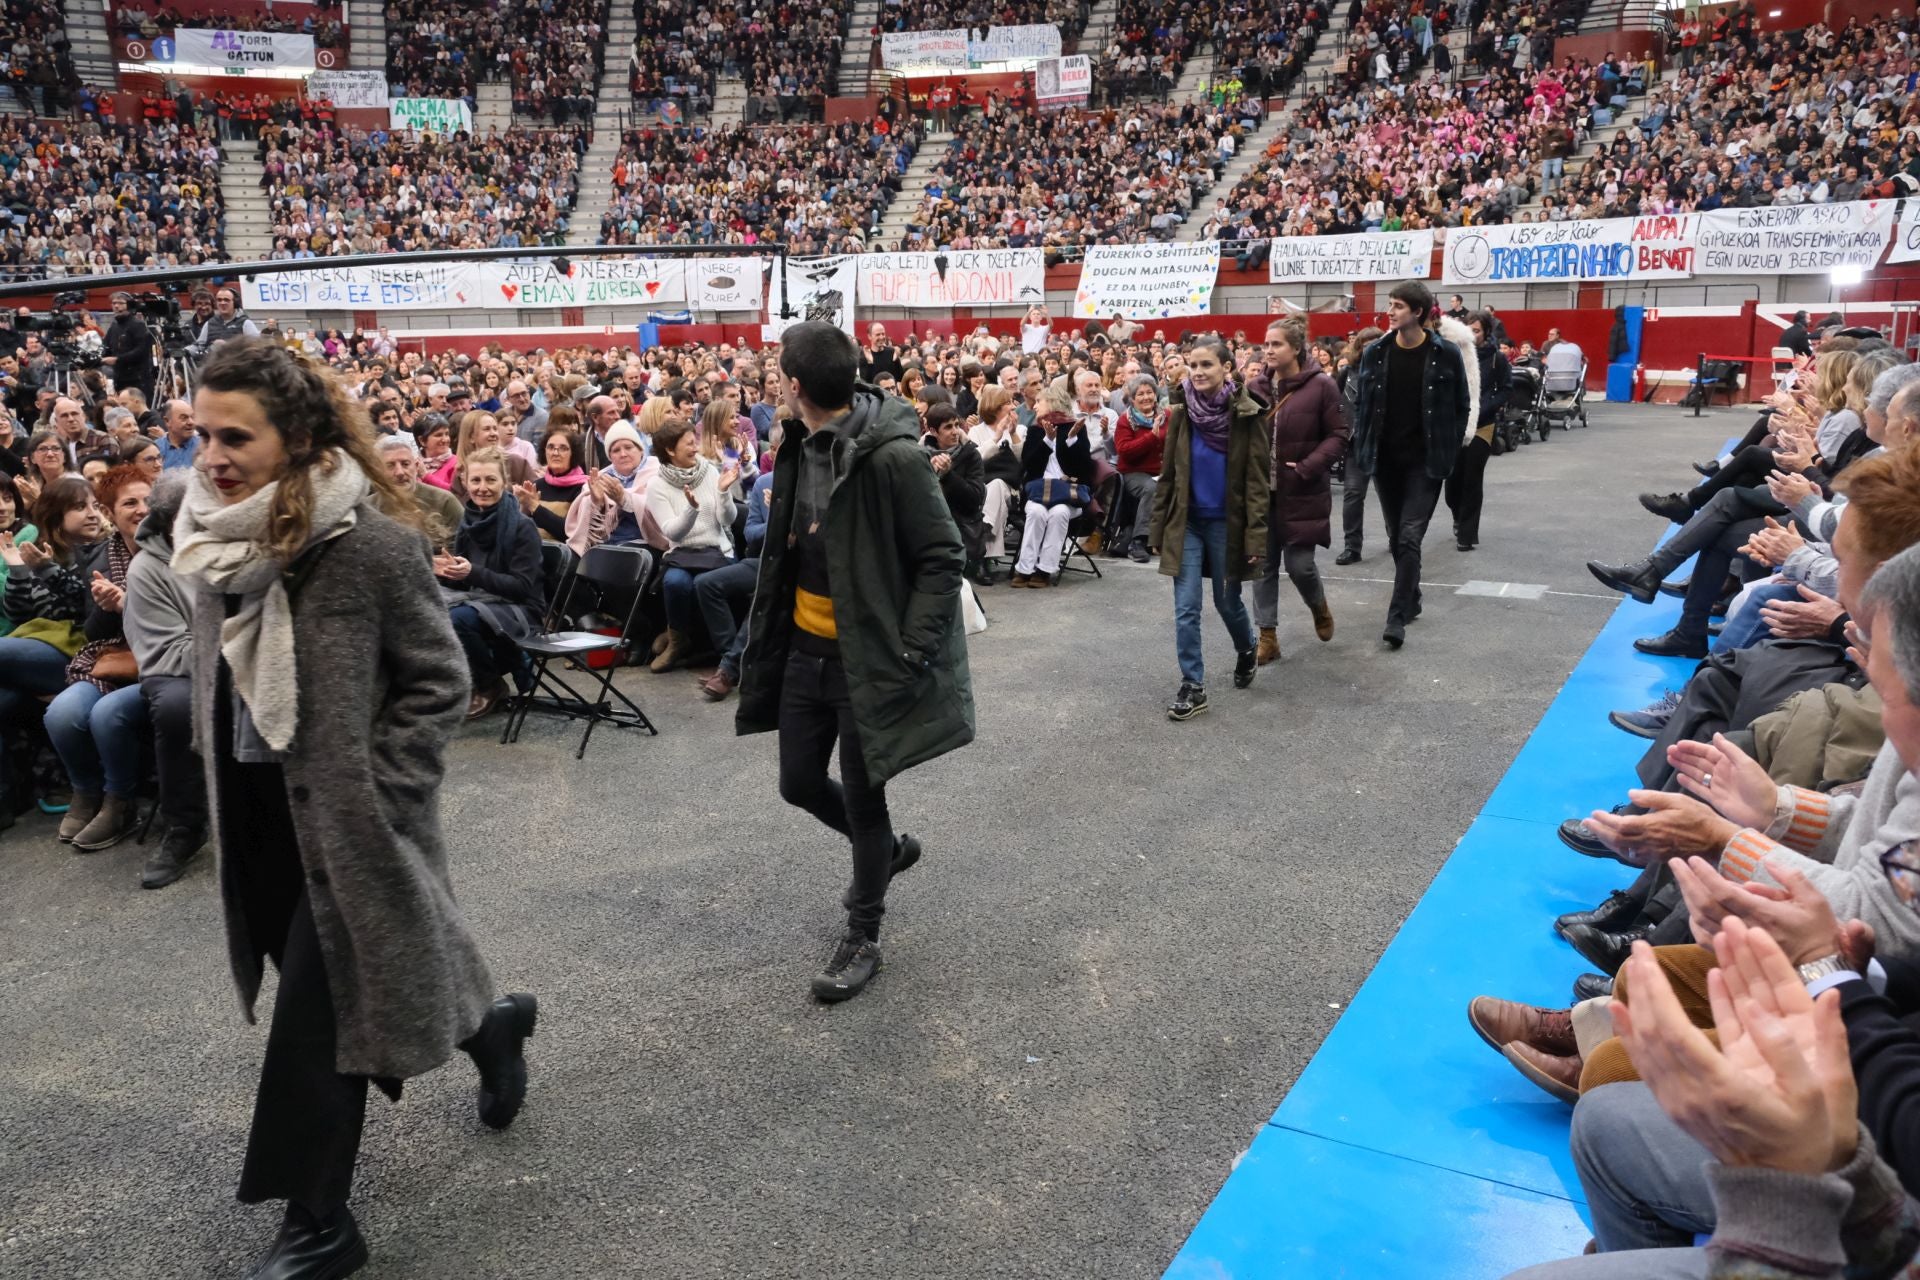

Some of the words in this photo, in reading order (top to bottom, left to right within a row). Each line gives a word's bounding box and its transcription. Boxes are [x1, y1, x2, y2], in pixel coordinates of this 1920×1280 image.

[227, 51, 274, 62] GATTUN
[1064, 56, 1085, 69] AUPA
[1061, 70, 1088, 82] NEREA
[1810, 206, 1851, 225] ASKO
[1632, 215, 1688, 241] AUPA!
[1700, 230, 1760, 249] GIPUZKOA
[1095, 249, 1153, 259] ZUREKIKO
[1156, 246, 1214, 259] SENTITZEN
[1705, 250, 1733, 268] EGIN
[1737, 254, 1783, 269] DUZUEN
[702, 263, 742, 275] NEREA
[861, 255, 891, 270] GAUR
[956, 253, 980, 270] DEK
[1093, 267, 1137, 277] DUGUN
[1140, 263, 1210, 276] MAITASUNA
[1274, 260, 1307, 277] ILUNBE
[1312, 258, 1361, 276] TOREATZIE
[371, 268, 425, 283] NEREA
[505, 265, 560, 283] AUPA
[580, 261, 658, 280] NEREA!
[258, 282, 308, 303] EUTSI
[318, 284, 341, 301] eta
[348, 284, 372, 303] EZ
[522, 284, 576, 303] EMAN
[586, 281, 643, 301] ZUREA
[871, 272, 919, 303] AUPA
[930, 271, 1013, 303] ANDONI!
[1106, 283, 1119, 292] EZ
[1122, 283, 1136, 292] DA
[703, 293, 741, 302] ZUREA
